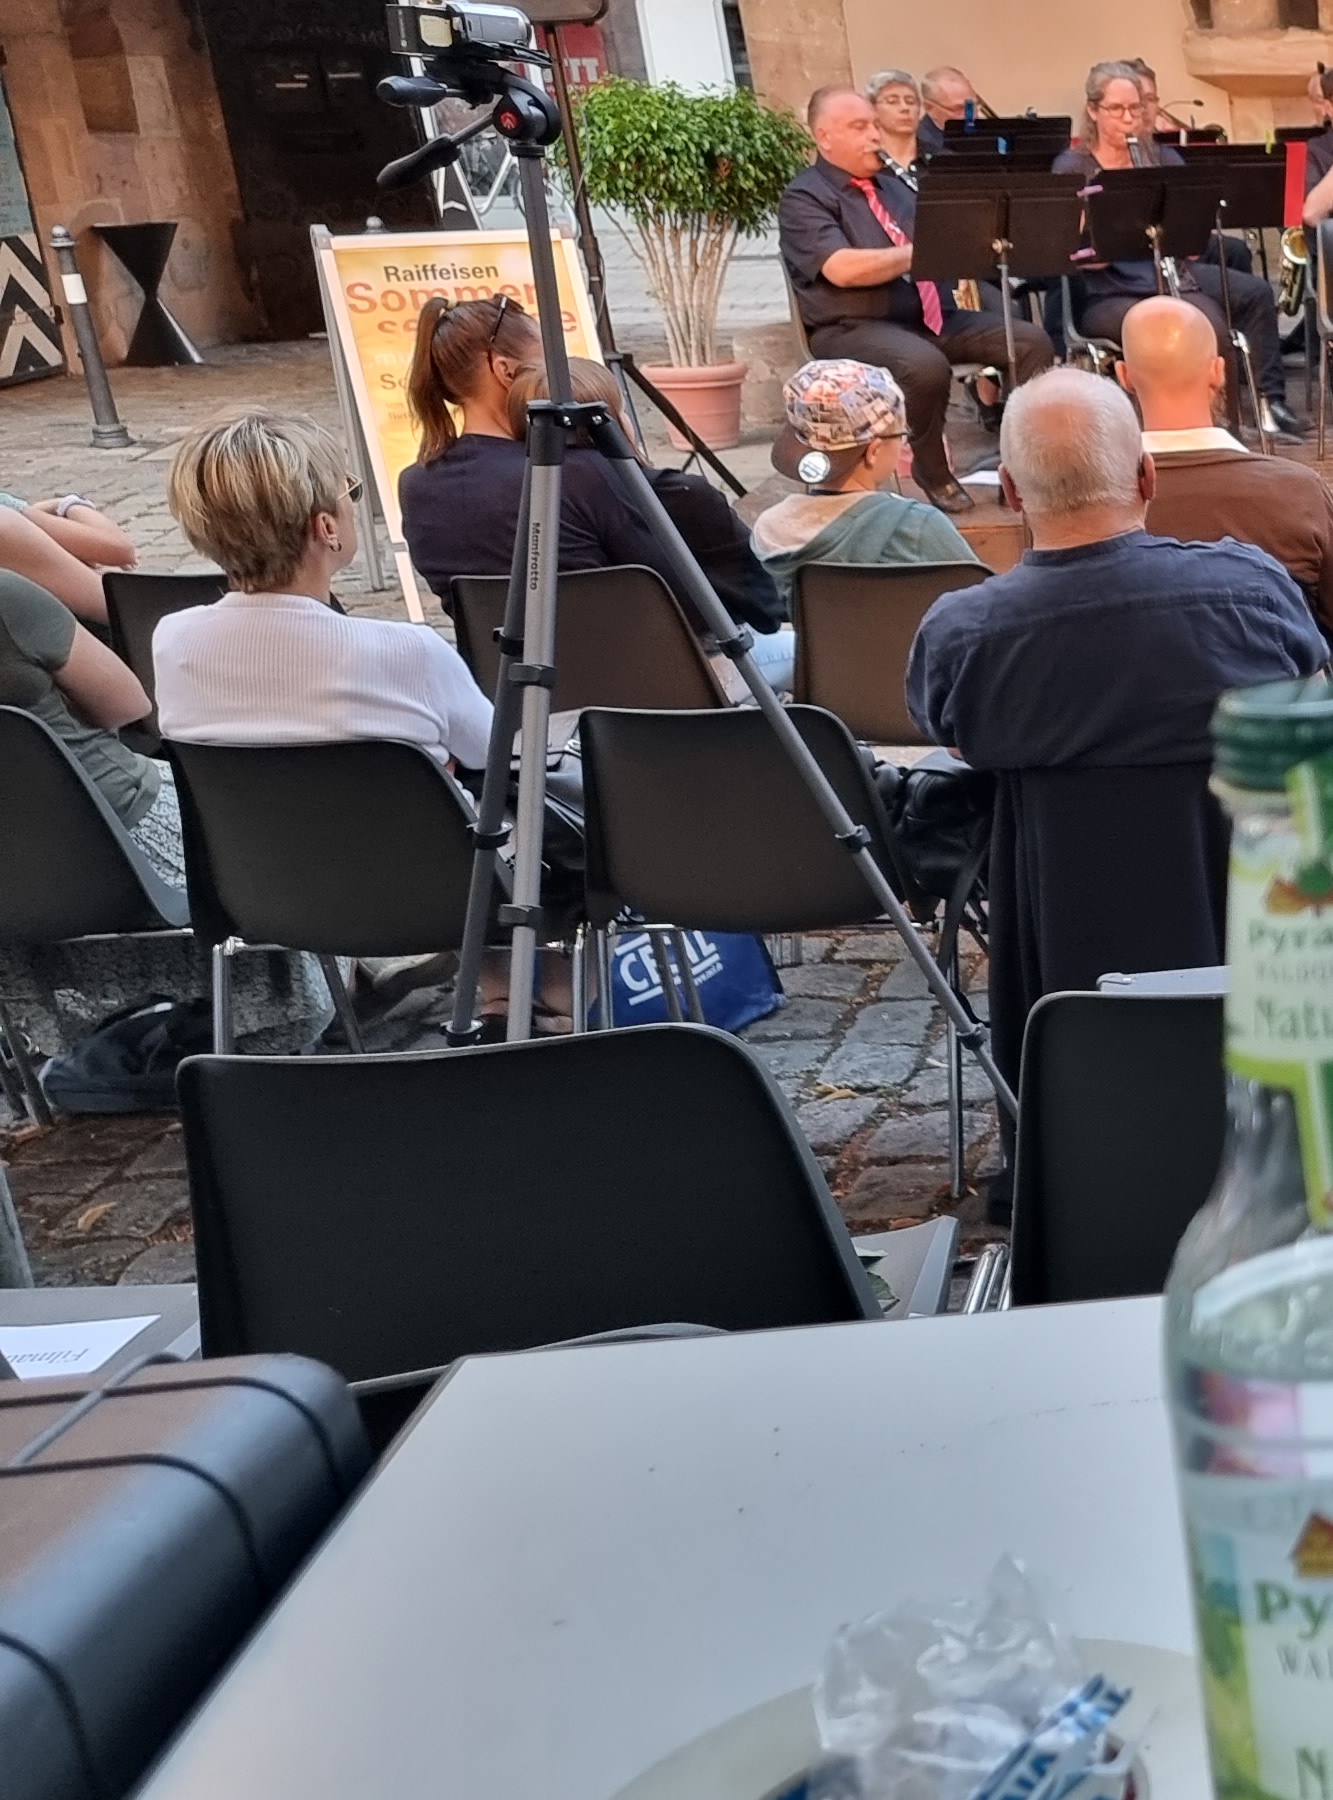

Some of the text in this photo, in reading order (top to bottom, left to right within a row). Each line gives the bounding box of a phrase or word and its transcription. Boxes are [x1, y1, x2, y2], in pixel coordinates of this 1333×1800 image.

[384, 263, 499, 283] Raiffeisen
[529, 522, 541, 590] Manfrotto
[619, 929, 716, 992] CEIL
